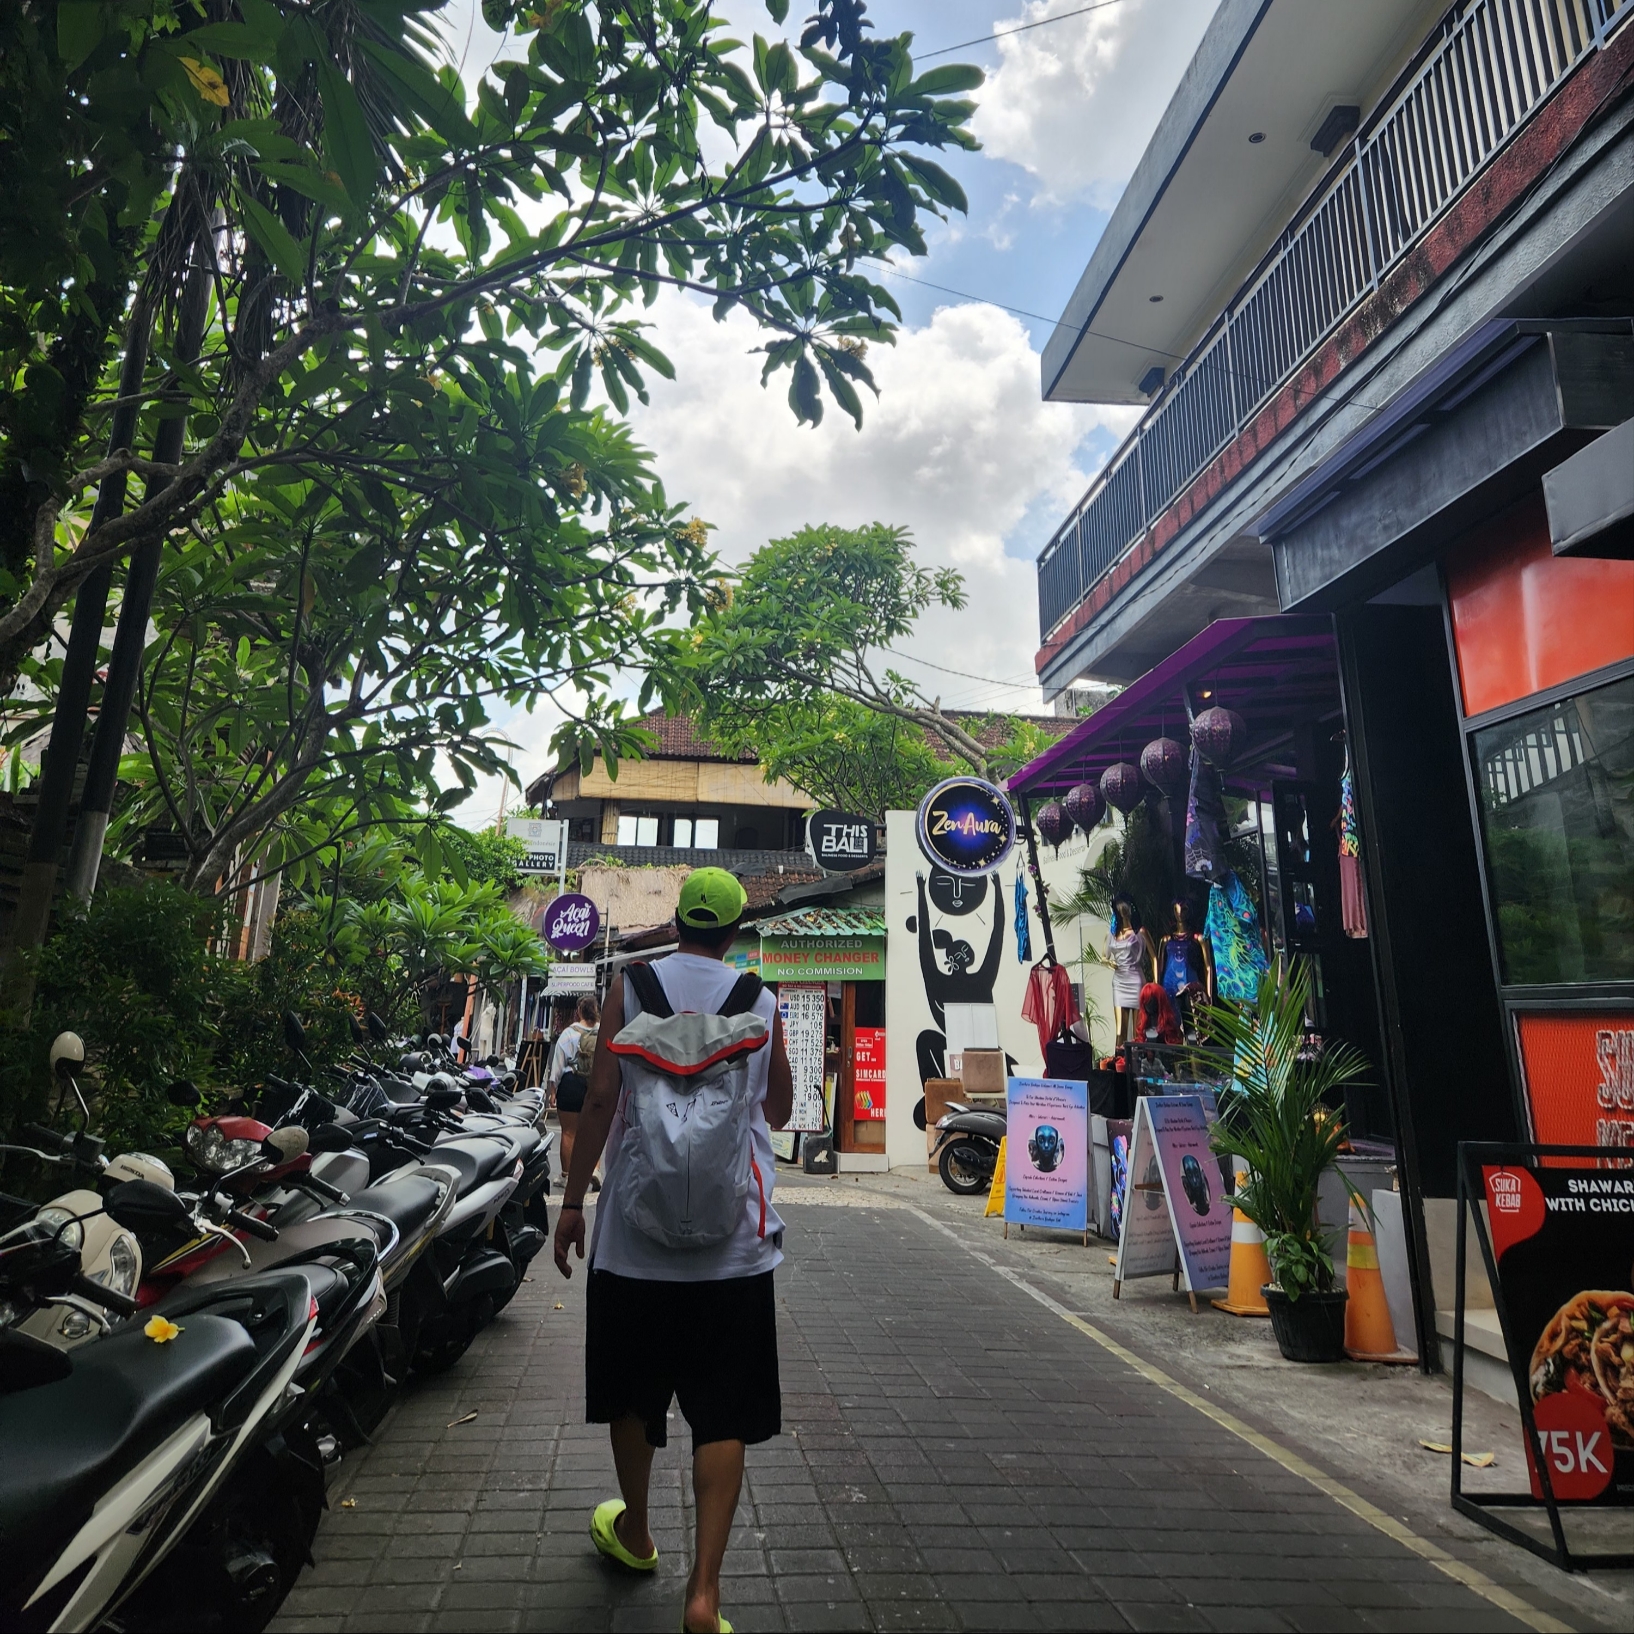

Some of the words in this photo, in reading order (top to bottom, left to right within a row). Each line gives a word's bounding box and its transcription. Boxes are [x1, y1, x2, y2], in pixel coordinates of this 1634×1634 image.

[824, 824, 868, 837] THIS
[822, 836, 868, 854] BALI
[551, 918, 590, 938] Queen
[780, 940, 862, 948] AUTHORIZED
[762, 952, 810, 964] MONEY
[814, 952, 879, 963] CHANGER
[810, 1021, 822, 1029] 105
[856, 1068, 886, 1079] SIMCARD
[1495, 1178, 1516, 1192] SUKA
[1496, 1194, 1521, 1208] KEBAB
[1545, 1197, 1585, 1211] WITH
